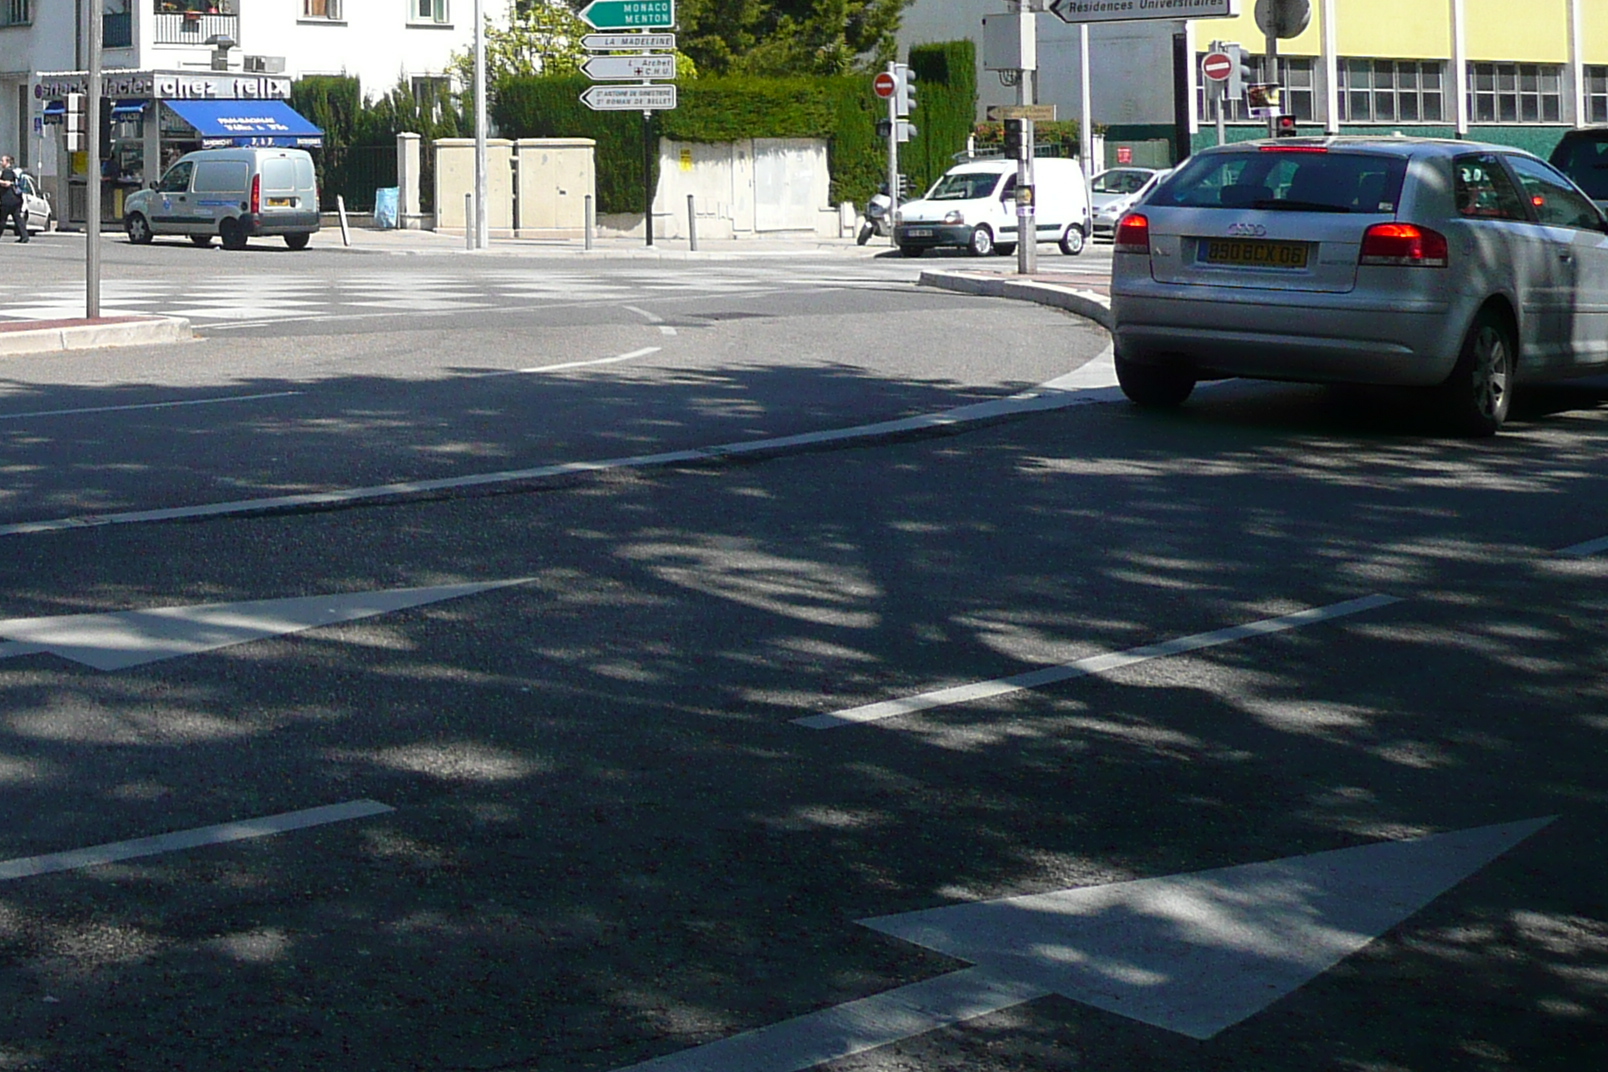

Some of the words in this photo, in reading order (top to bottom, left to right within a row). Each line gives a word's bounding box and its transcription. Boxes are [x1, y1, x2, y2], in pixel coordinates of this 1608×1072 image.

[623, 2, 669, 13] MONACO
[1069, 0, 1134, 13] Résidences
[624, 13, 669, 24] MENTON
[604, 37, 616, 46] LA
[621, 37, 671, 46] MADELEINE
[42, 79, 88, 95] snack
[102, 77, 152, 95] lacier
[161, 78, 219, 96] chez
[234, 77, 287, 96] felix
[647, 97, 671, 105] BELLET
